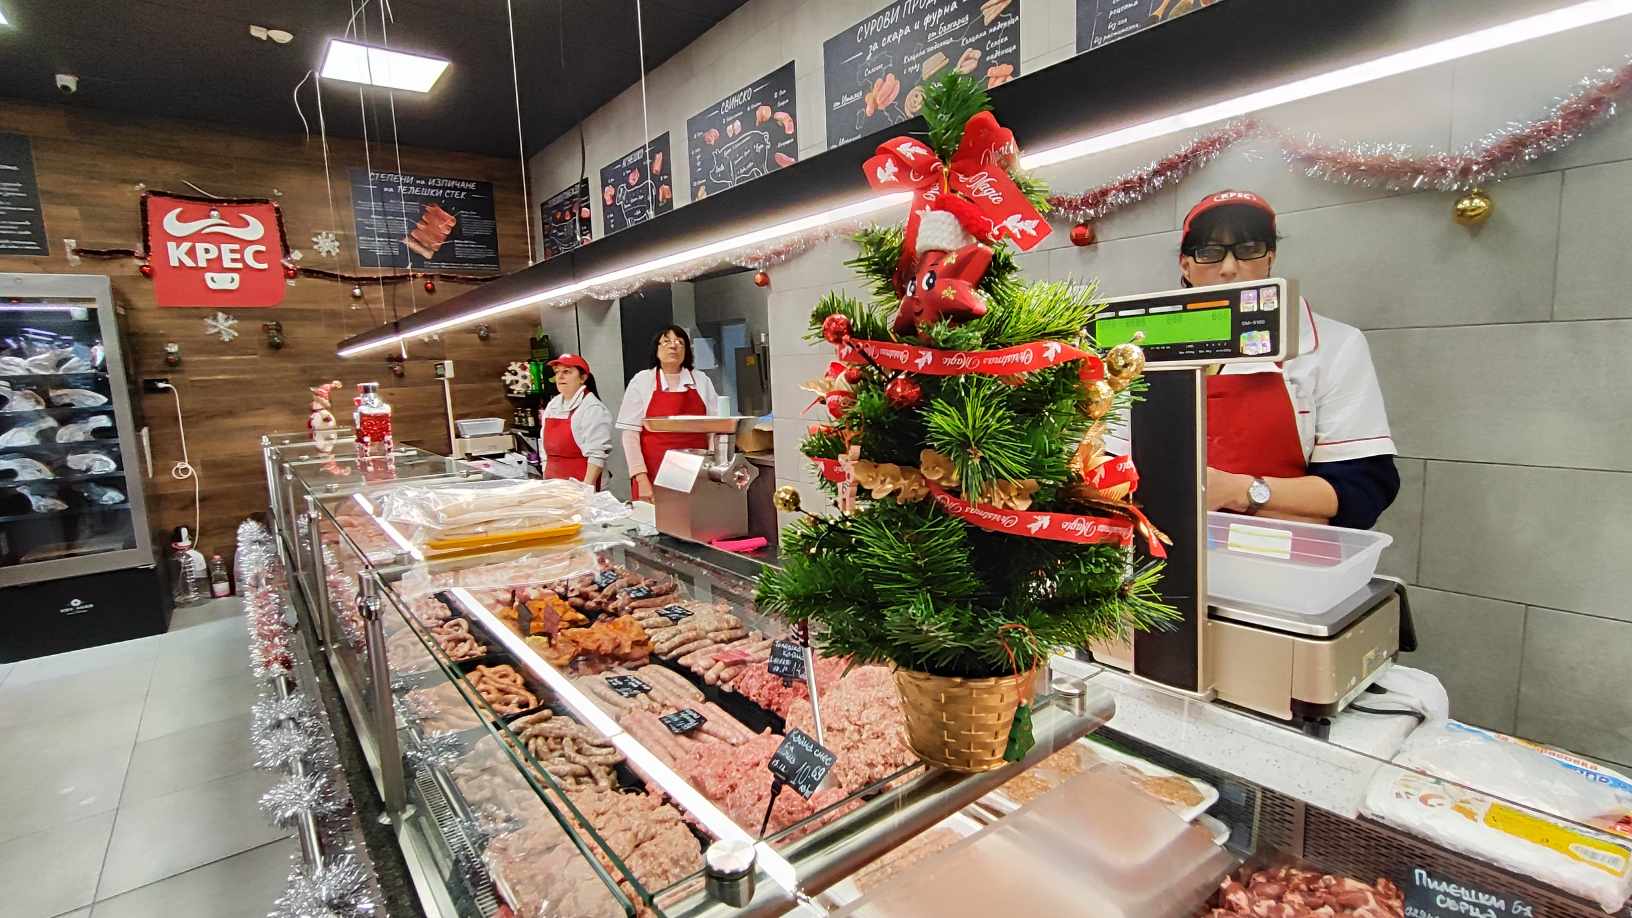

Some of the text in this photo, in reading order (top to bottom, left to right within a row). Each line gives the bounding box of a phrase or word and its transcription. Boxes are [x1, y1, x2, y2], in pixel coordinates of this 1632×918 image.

[856, 5, 900, 43] СУРОВИ
[866, 2, 958, 62] за скара и фурна
[720, 87, 752, 115] СВИНСКО
[370, 172, 414, 184] СТЕПЕНИ
[428, 178, 478, 190] ИЗПИЧАНЕ
[397, 185, 443, 198] ТЕЛЕШКИ
[445, 190, 468, 200] СТЕК
[166, 241, 269, 270] КРЕС
[942, 352, 981, 370] Magic
[982, 348, 1034, 367] Christmas
[964, 505, 1019, 528] Christmas
[1061, 517, 1097, 538] Magic
